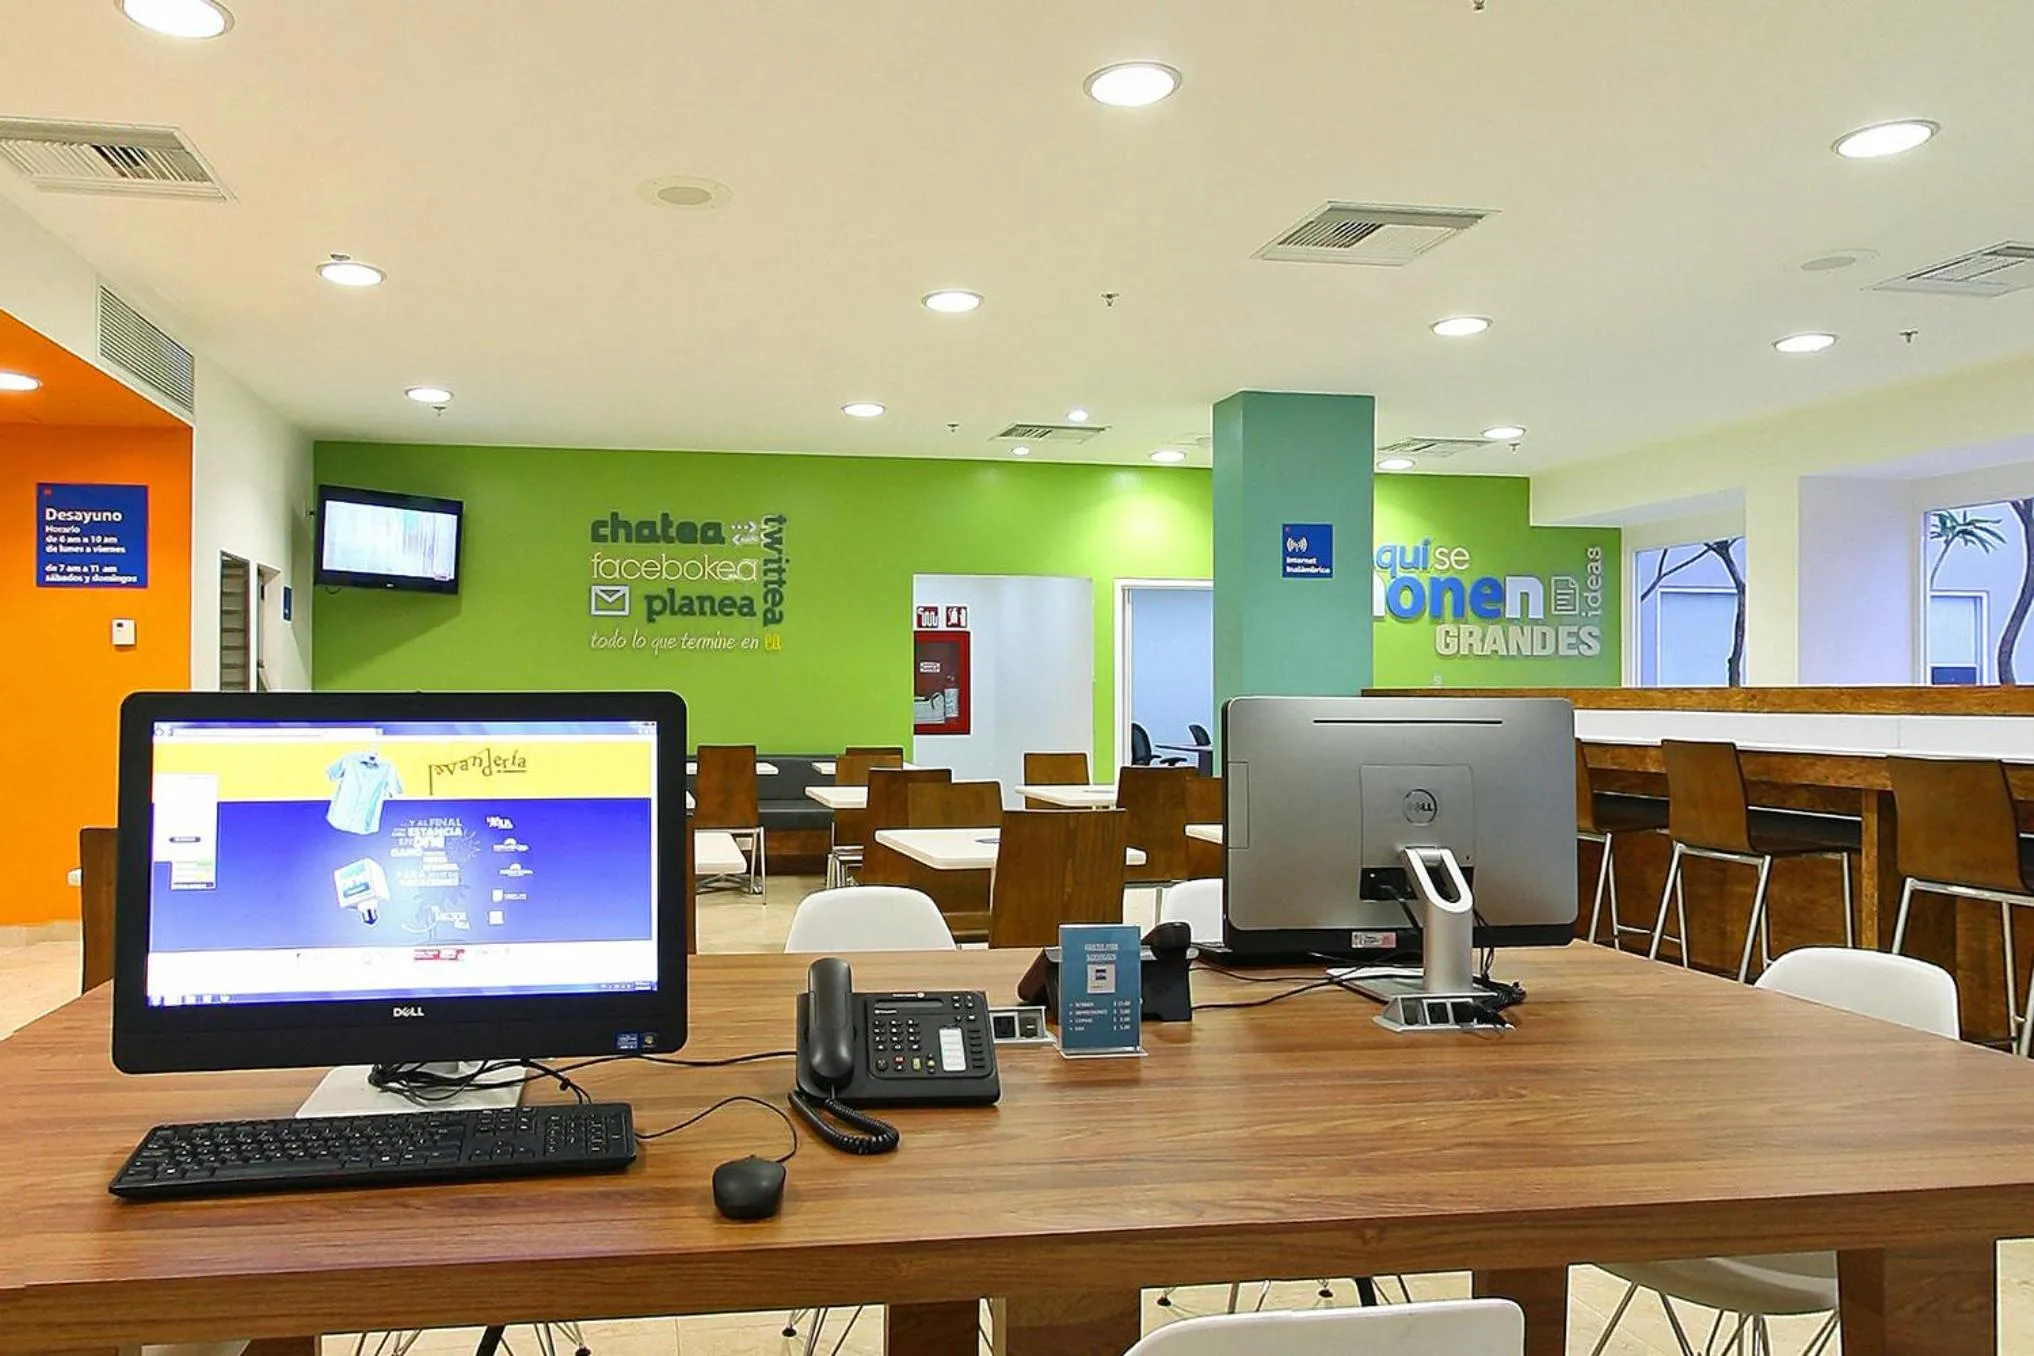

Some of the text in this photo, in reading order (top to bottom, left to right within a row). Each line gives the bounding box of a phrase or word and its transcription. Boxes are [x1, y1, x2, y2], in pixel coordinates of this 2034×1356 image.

[45, 508, 123, 524] Desayuno
[591, 512, 725, 545] chatea
[45, 525, 81, 534] Horario
[45, 545, 58, 553] de
[1434, 547, 1470, 570] se
[59, 564, 65, 572] 7
[590, 552, 758, 581] facebokea
[763, 514, 790, 627] twittea
[1582, 546, 1602, 618] ideas
[643, 588, 757, 623] planea
[591, 628, 627, 649] todo
[632, 629, 646, 649] lo
[651, 636, 678, 655] que
[681, 631, 736, 650] termine
[741, 637, 759, 650] en
[1435, 624, 1601, 656] GRANDES
[429, 818, 463, 827] FINAL
[393, 1006, 425, 1018] DELL
